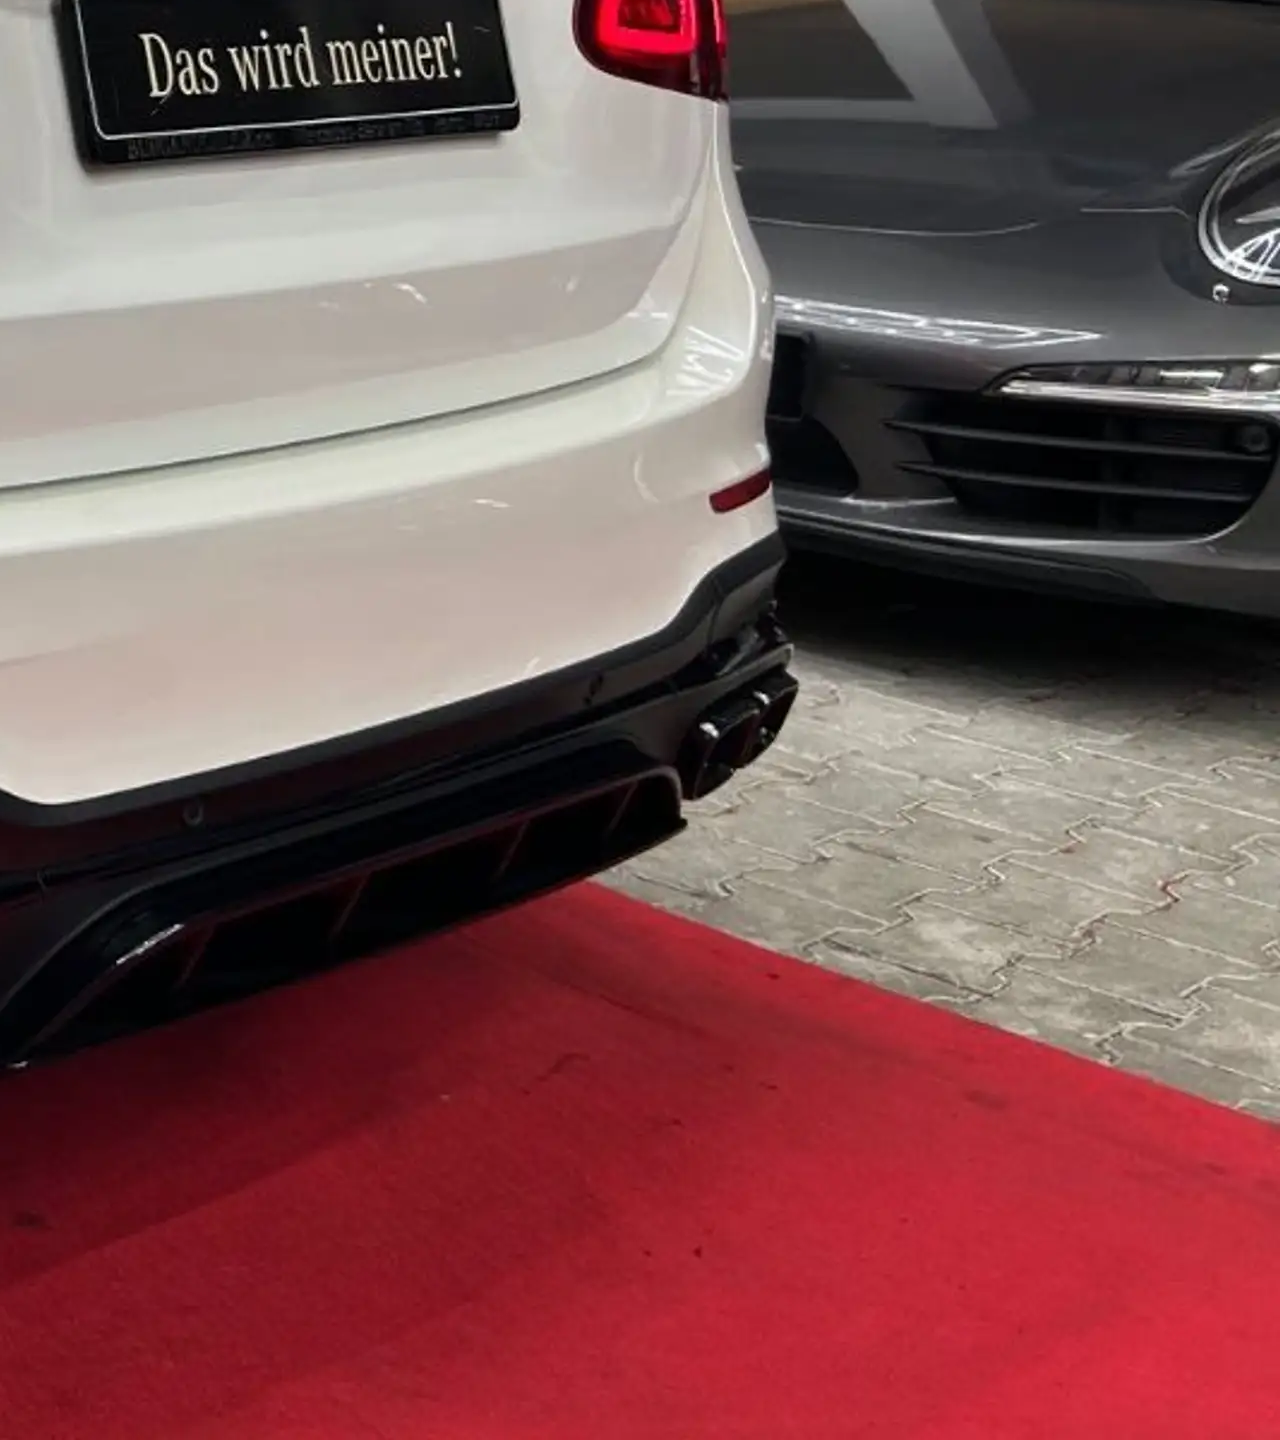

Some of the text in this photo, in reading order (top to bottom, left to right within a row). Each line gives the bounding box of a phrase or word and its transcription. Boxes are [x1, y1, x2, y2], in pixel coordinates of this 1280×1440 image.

[137, 20, 462, 98] Das wird meiner!
